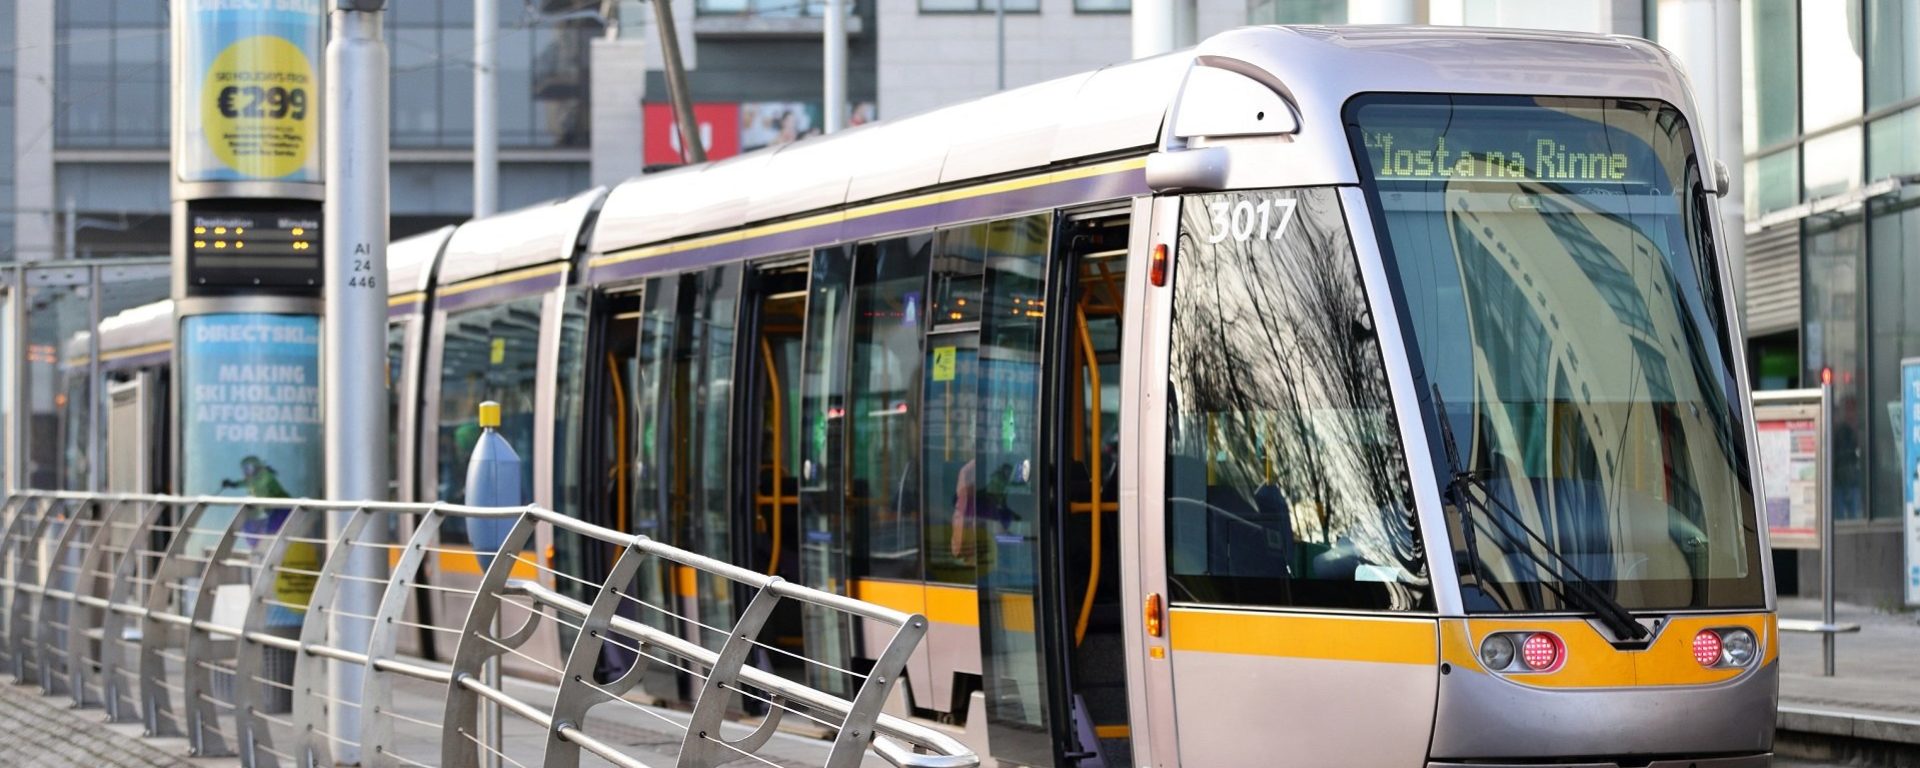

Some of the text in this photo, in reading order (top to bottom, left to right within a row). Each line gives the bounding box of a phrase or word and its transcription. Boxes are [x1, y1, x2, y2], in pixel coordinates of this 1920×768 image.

[217, 86, 307, 120] €299
[1486, 151, 1525, 179] na
[1536, 138, 1628, 180] Rinne
[1209, 198, 1297, 244] 3017
[354, 260, 371, 271] 24
[348, 276, 376, 289] 446
[219, 365, 305, 383] MAKING
[196, 384, 227, 402] SKI
[216, 424, 259, 442] FOR
